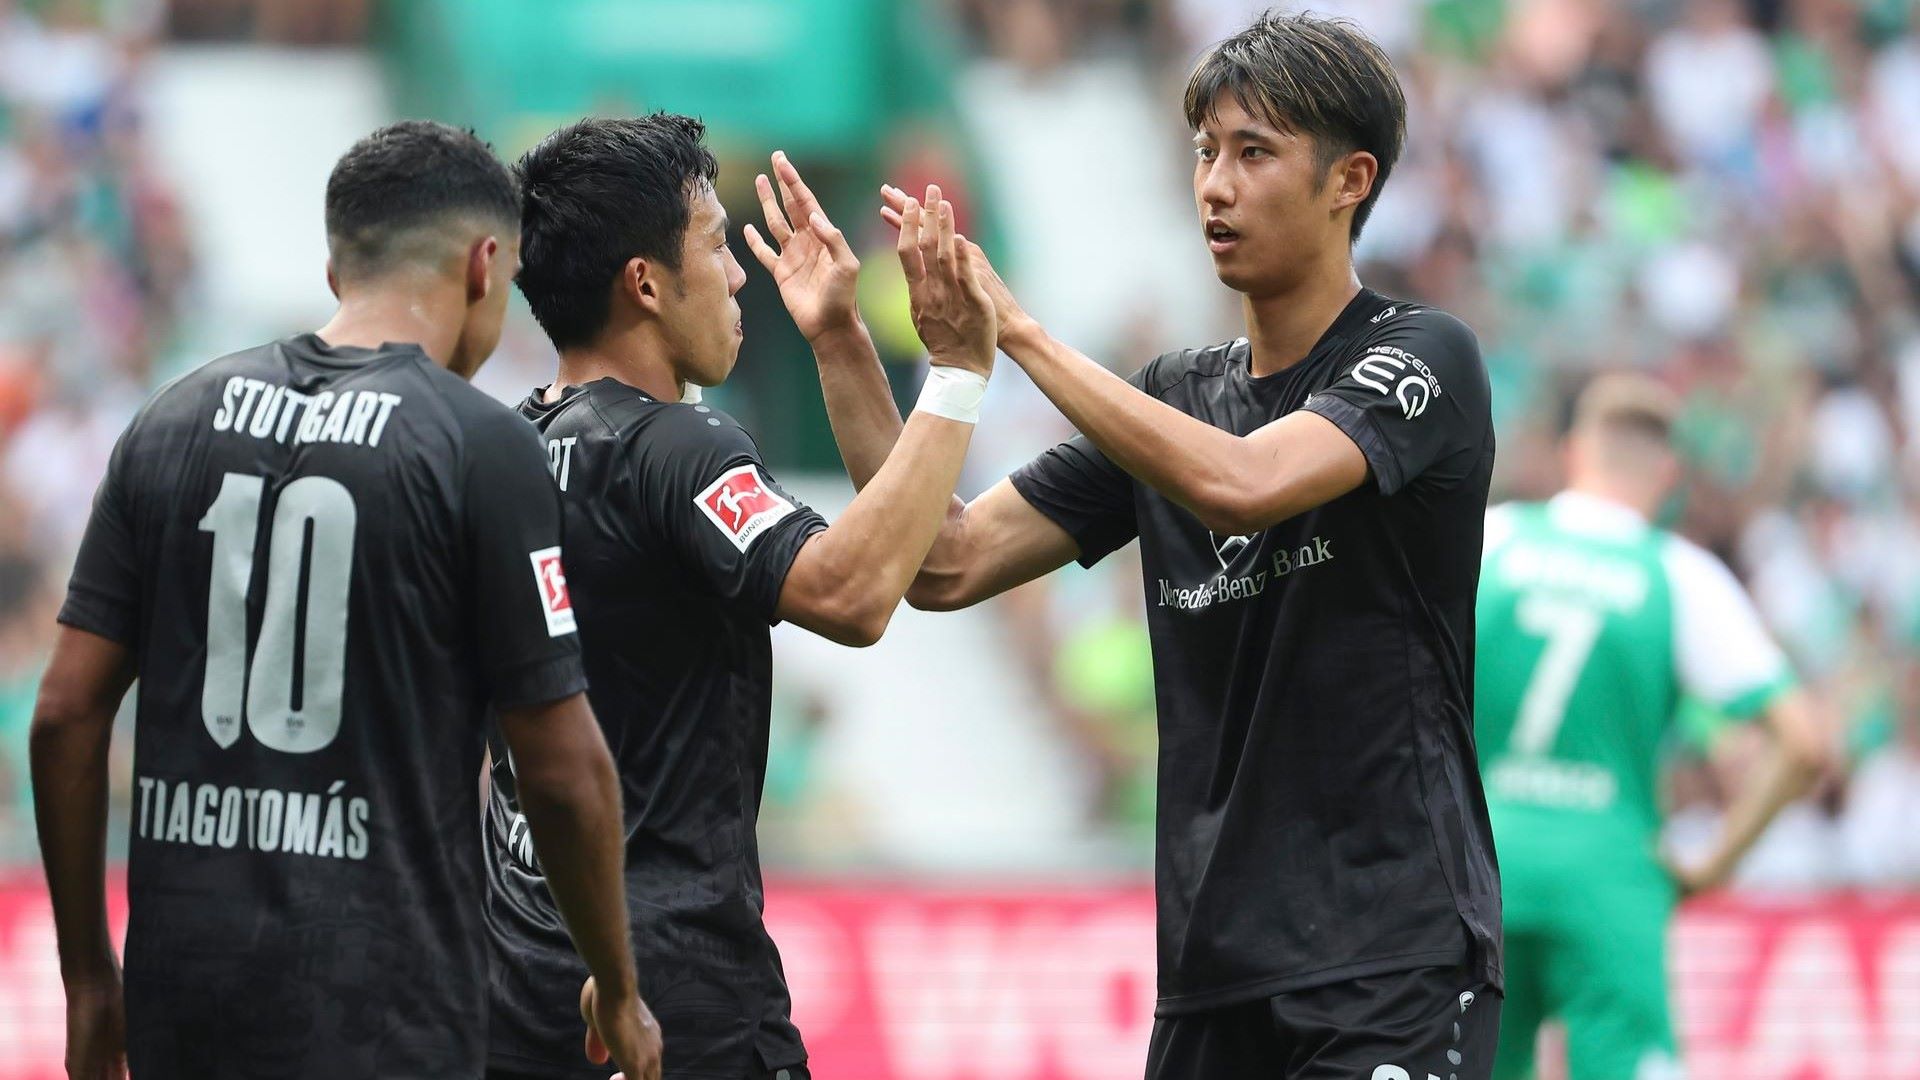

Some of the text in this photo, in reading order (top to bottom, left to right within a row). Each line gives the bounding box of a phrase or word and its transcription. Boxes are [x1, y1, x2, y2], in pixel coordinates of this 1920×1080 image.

[1351, 354, 1430, 420] EQ
[1367, 346, 1441, 398] MERCEDES
[213, 376, 402, 448] STUTTGART
[1157, 536, 1334, 609] Mcedes-Benz Bank
[198, 472, 357, 754] 10
[1513, 594, 1604, 754] 7
